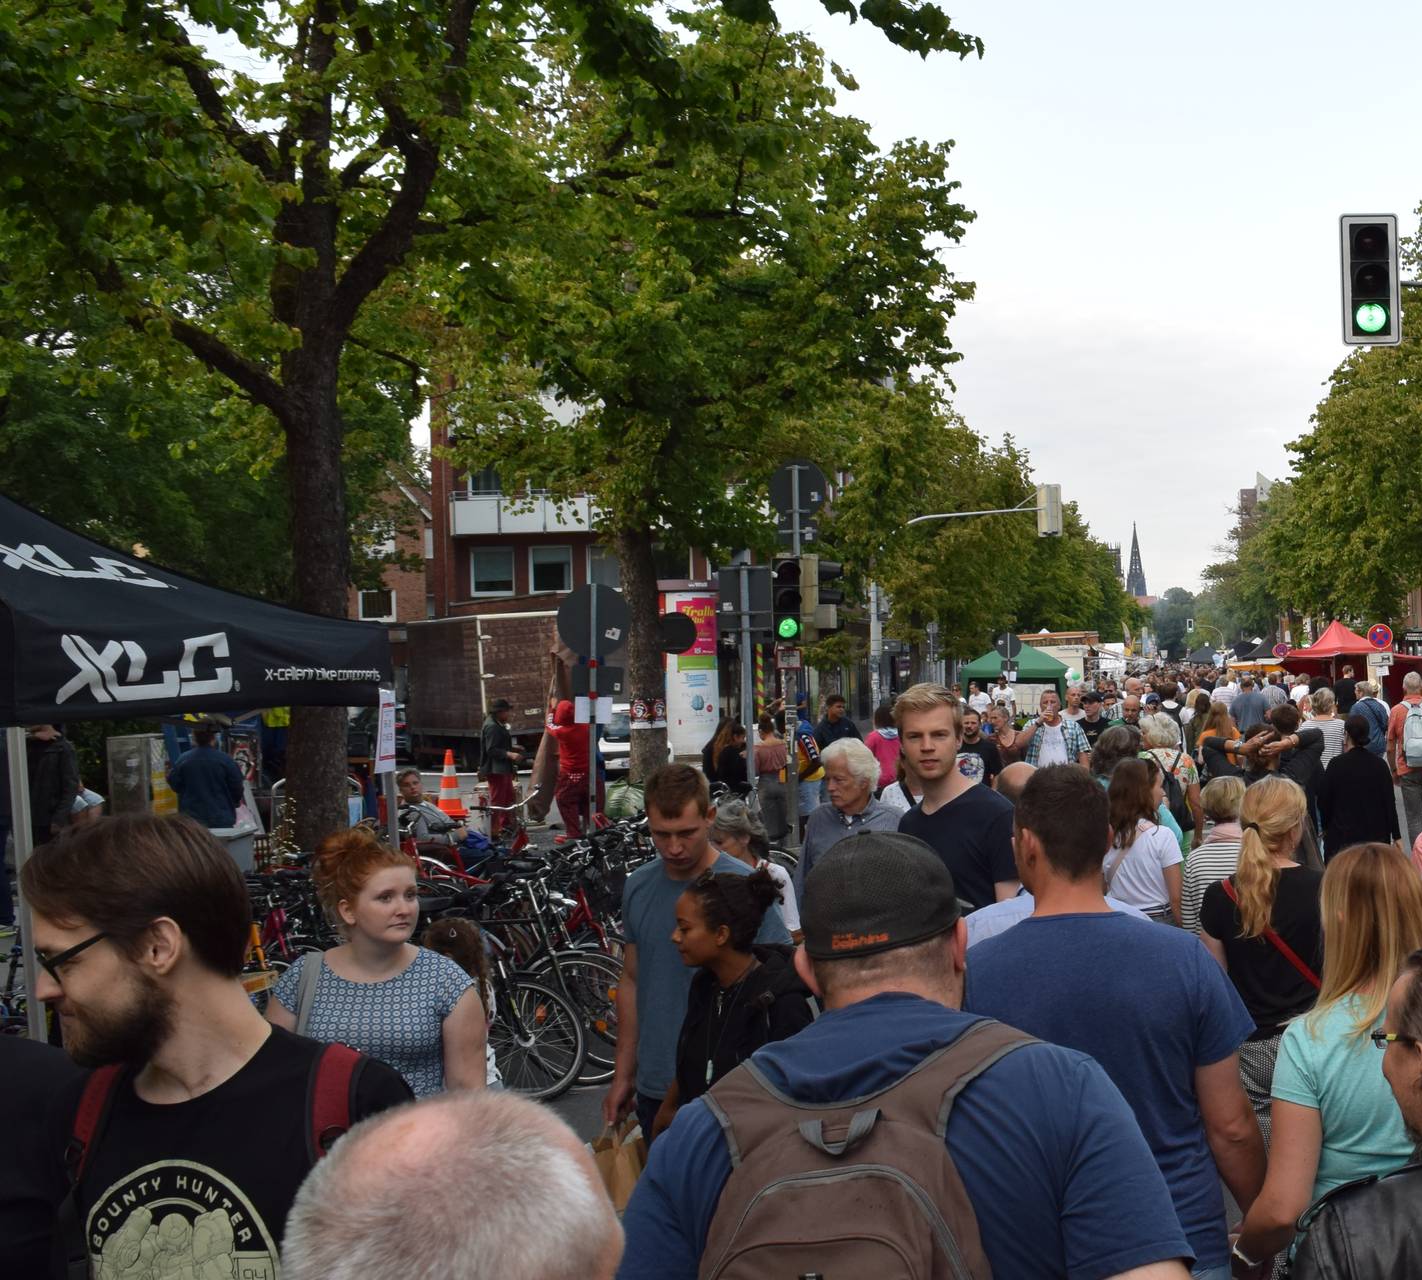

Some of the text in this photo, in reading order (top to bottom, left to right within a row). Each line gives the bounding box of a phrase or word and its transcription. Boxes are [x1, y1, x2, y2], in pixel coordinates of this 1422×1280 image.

[55, 632, 234, 705] XLC
[92, 1175, 253, 1248] BOUNTY HUNTER
